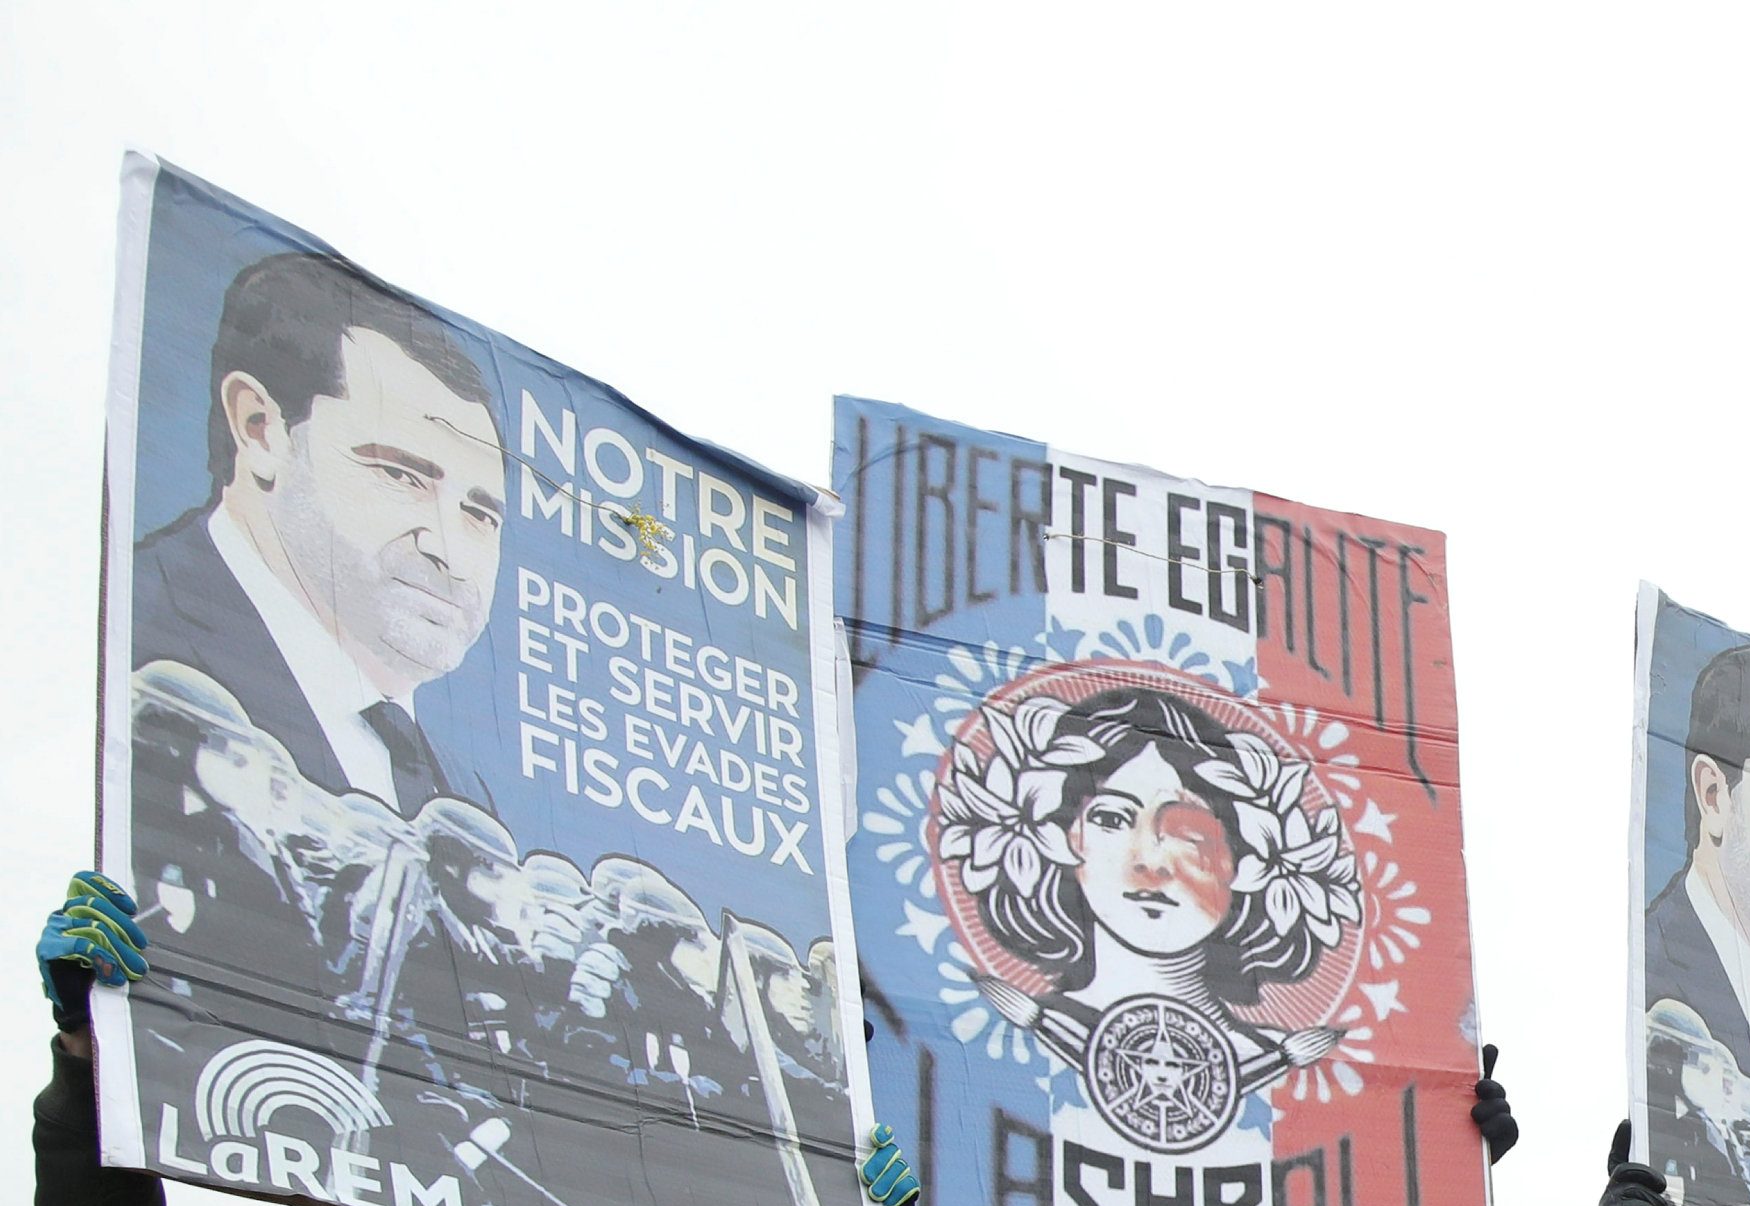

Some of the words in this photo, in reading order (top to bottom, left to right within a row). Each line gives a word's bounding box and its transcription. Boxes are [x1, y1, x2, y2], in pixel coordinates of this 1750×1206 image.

[519, 389, 797, 572] NOTRE
[520, 462, 799, 632] MISSION
[517, 566, 800, 720] PROTEGER
[518, 616, 589, 683] ET
[608, 656, 805, 769] SERVIR
[518, 671, 608, 742] LES
[625, 714, 811, 815] EVADES
[519, 720, 815, 876] FISCAUX
